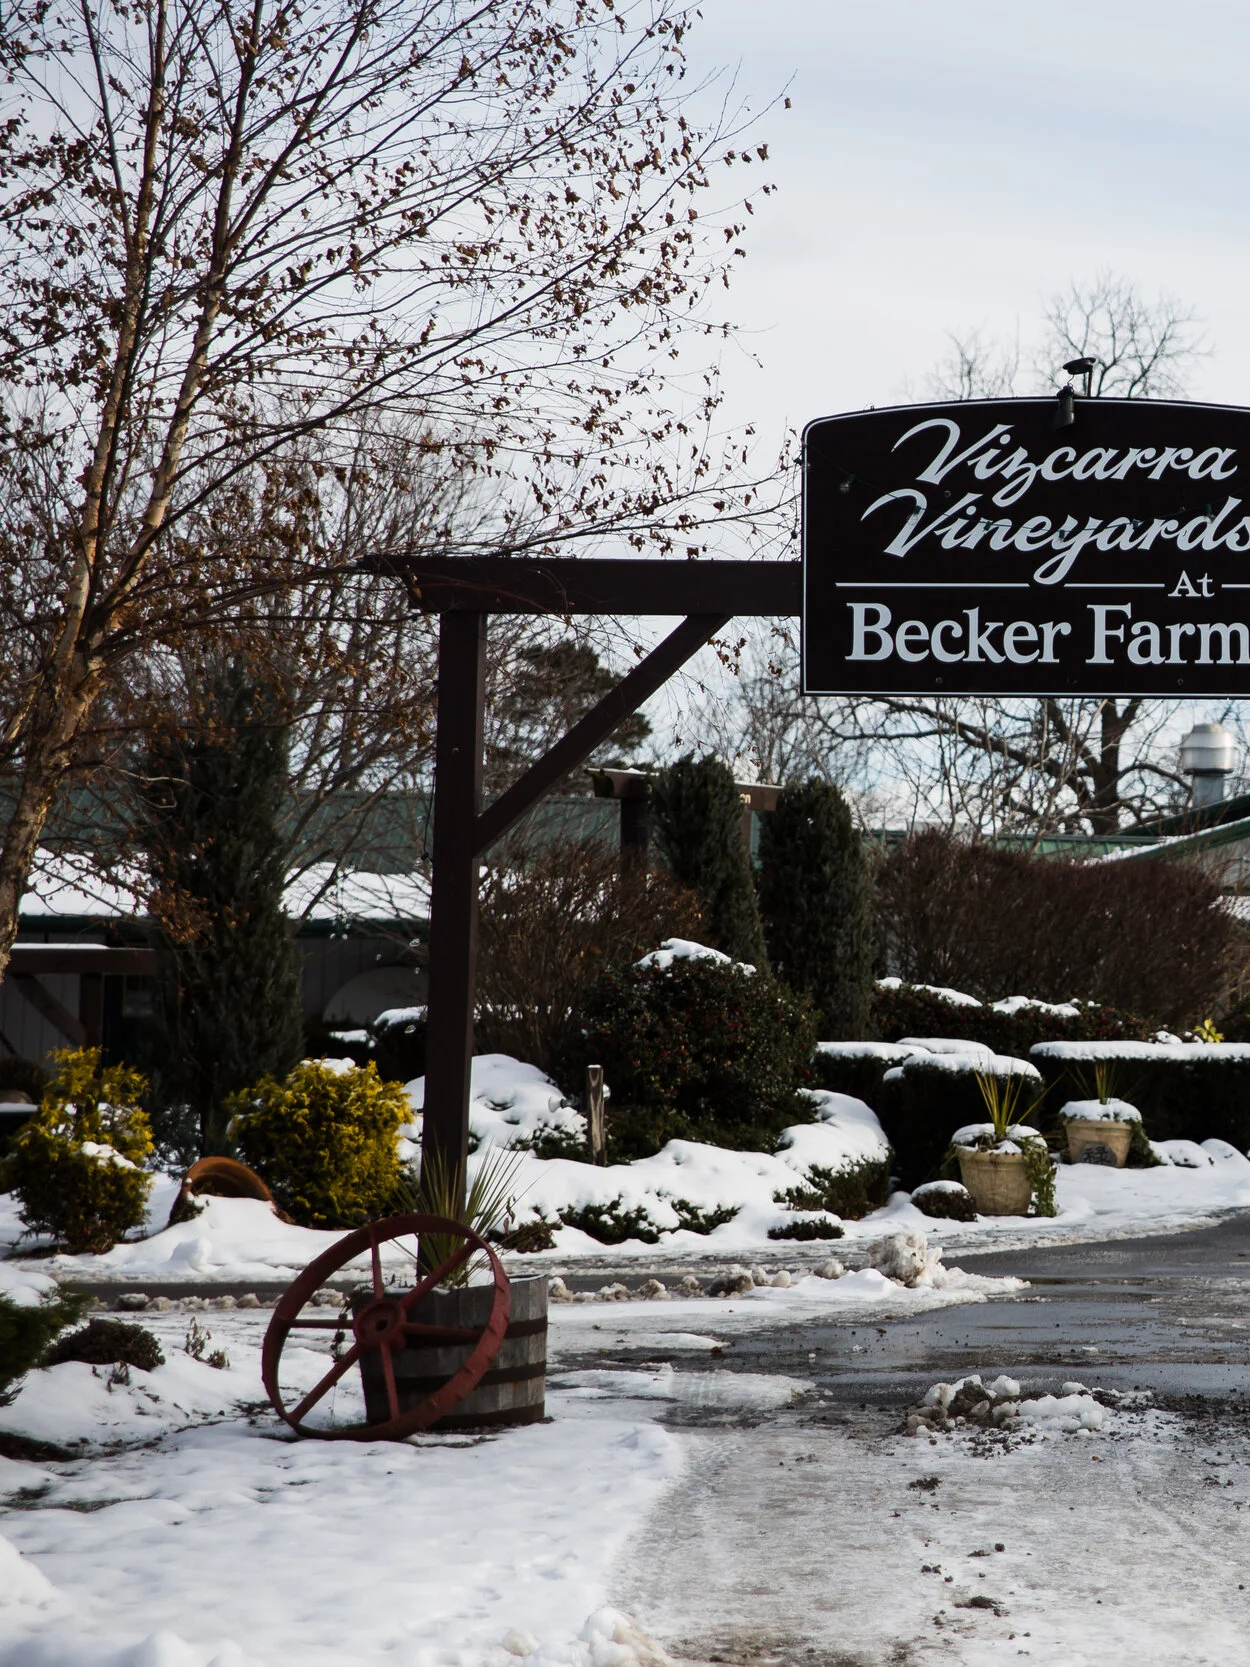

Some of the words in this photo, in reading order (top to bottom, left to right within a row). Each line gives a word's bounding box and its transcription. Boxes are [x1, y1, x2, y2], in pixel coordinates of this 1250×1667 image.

[891, 417, 1238, 508] Vizcarra
[1167, 570, 1215, 598] At
[844, 602, 1072, 664] Becker
